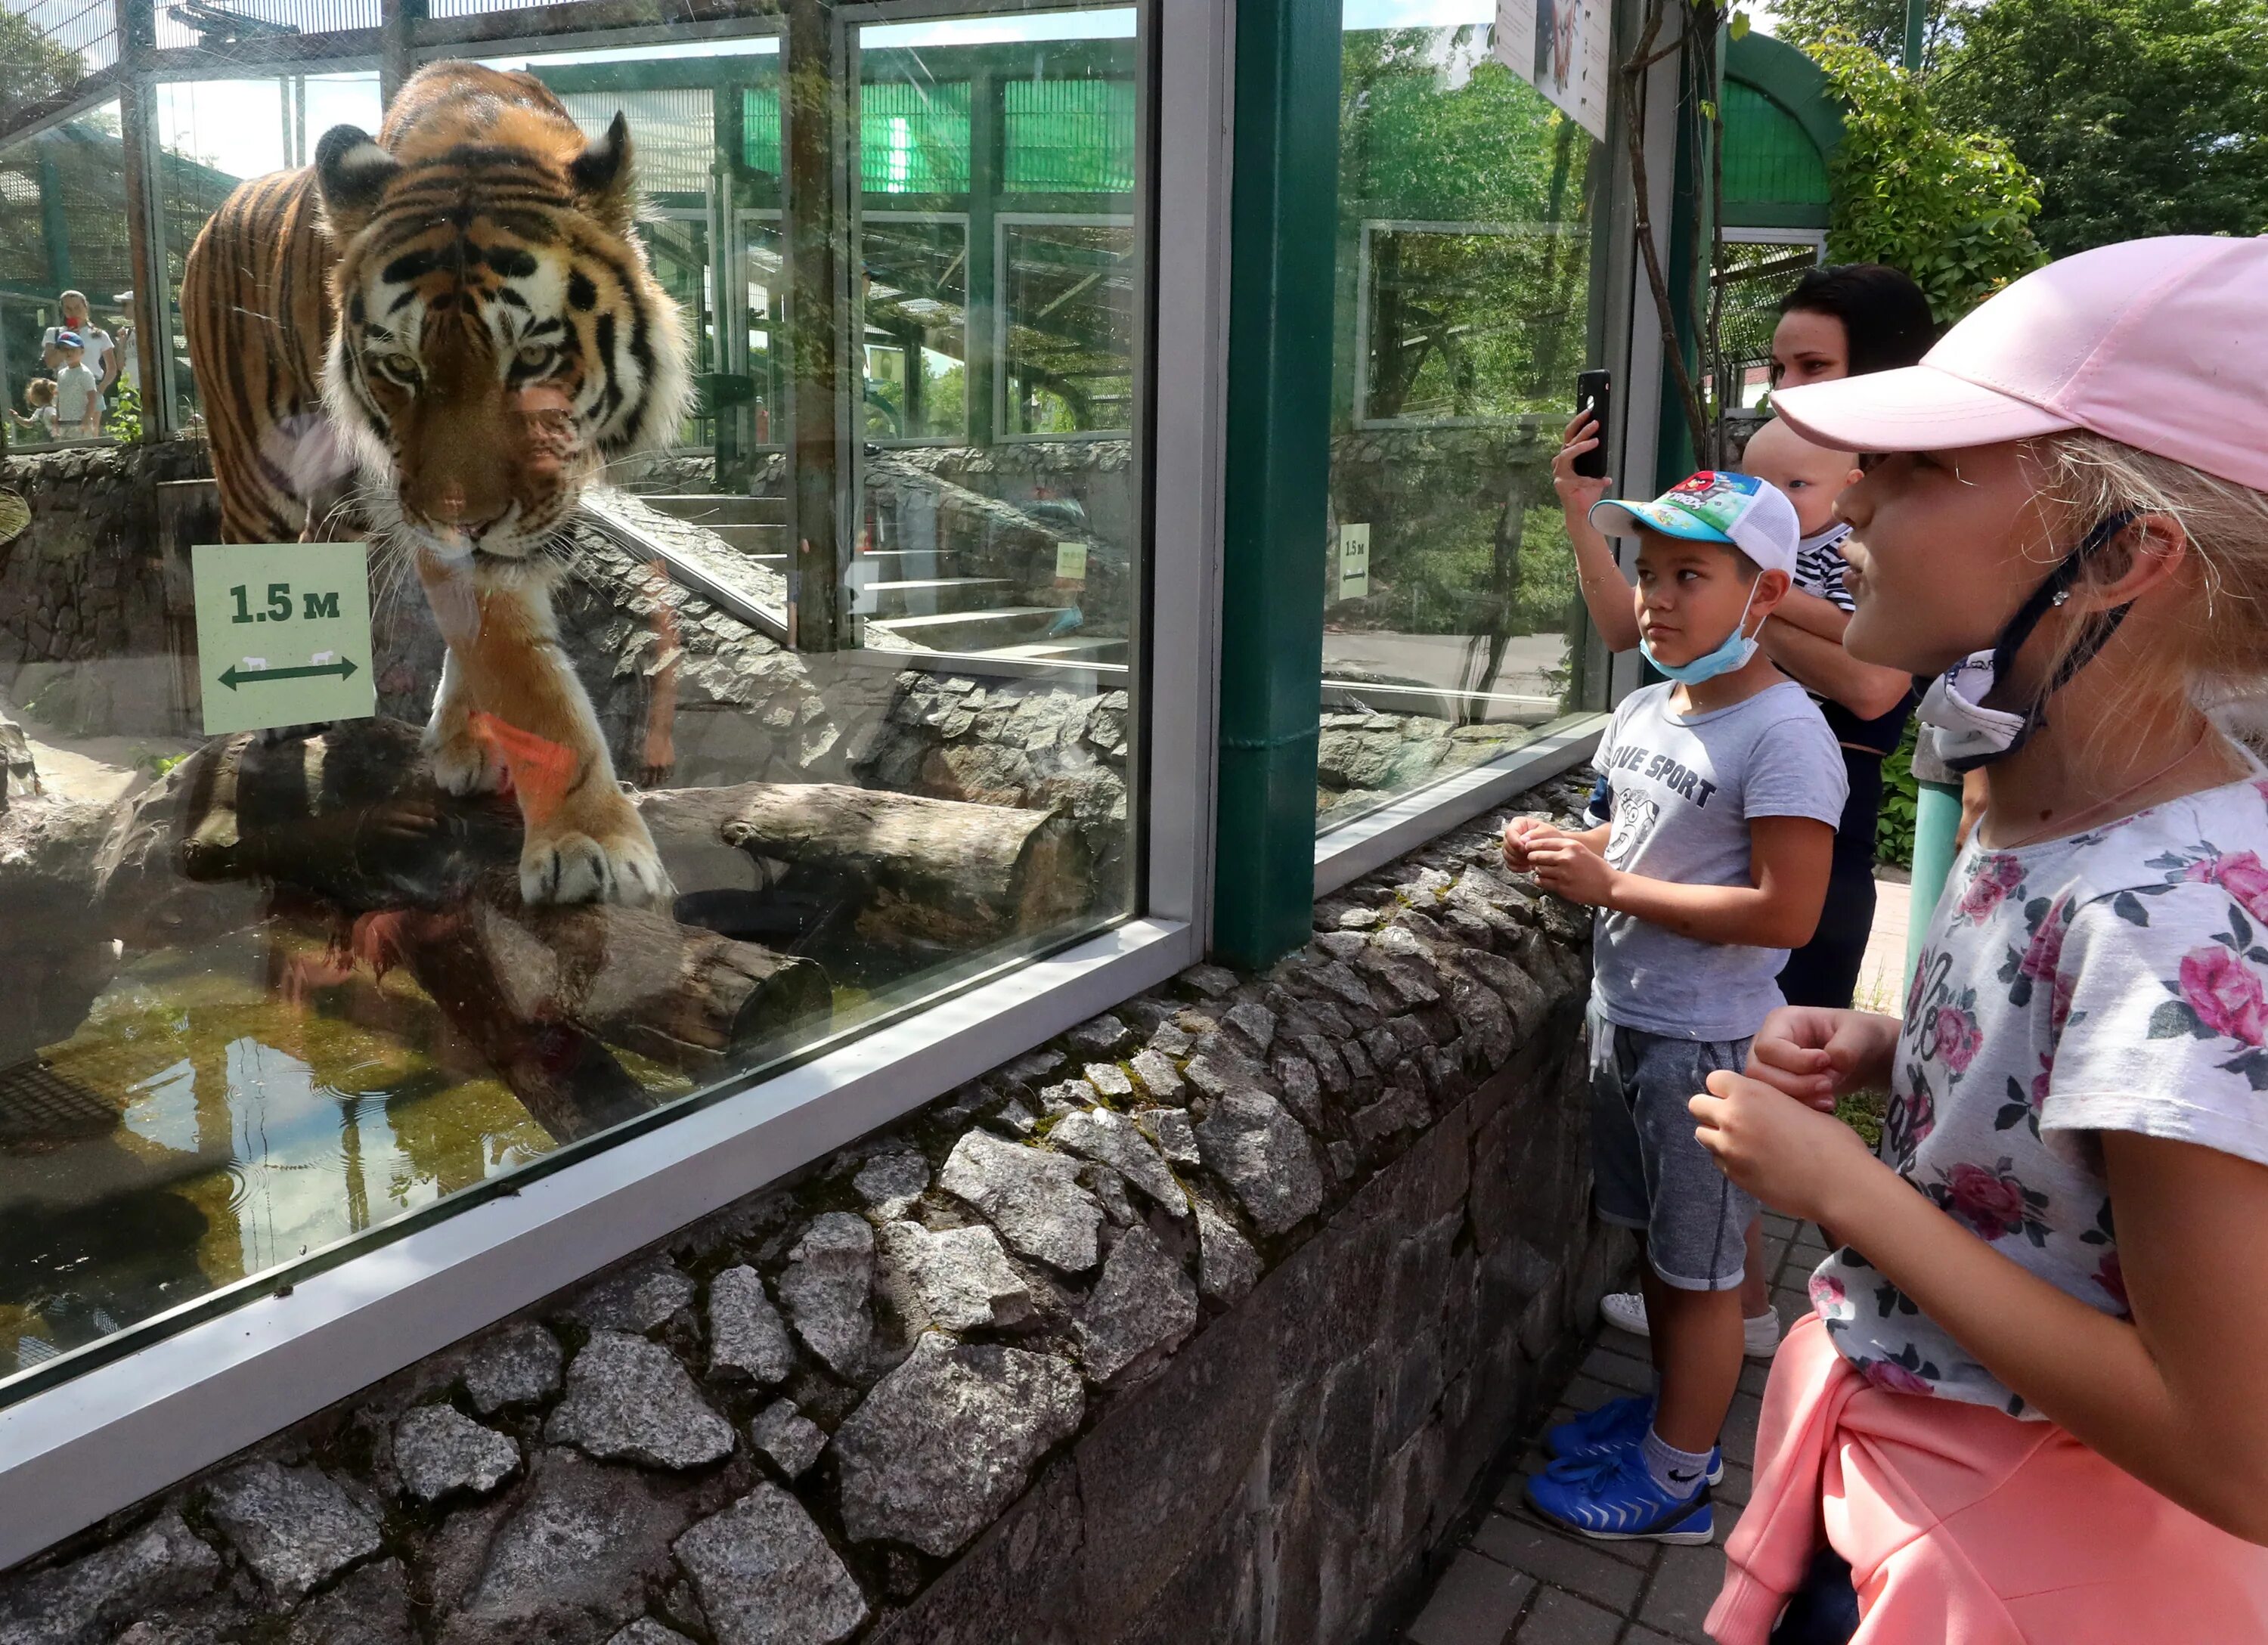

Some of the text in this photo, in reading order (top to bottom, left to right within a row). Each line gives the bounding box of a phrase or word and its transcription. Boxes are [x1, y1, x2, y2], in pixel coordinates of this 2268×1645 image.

[1346, 541, 1356, 556] 1.5
[230, 584, 293, 623] 1.5
[1610, 745, 1717, 810] OVE SPORT
